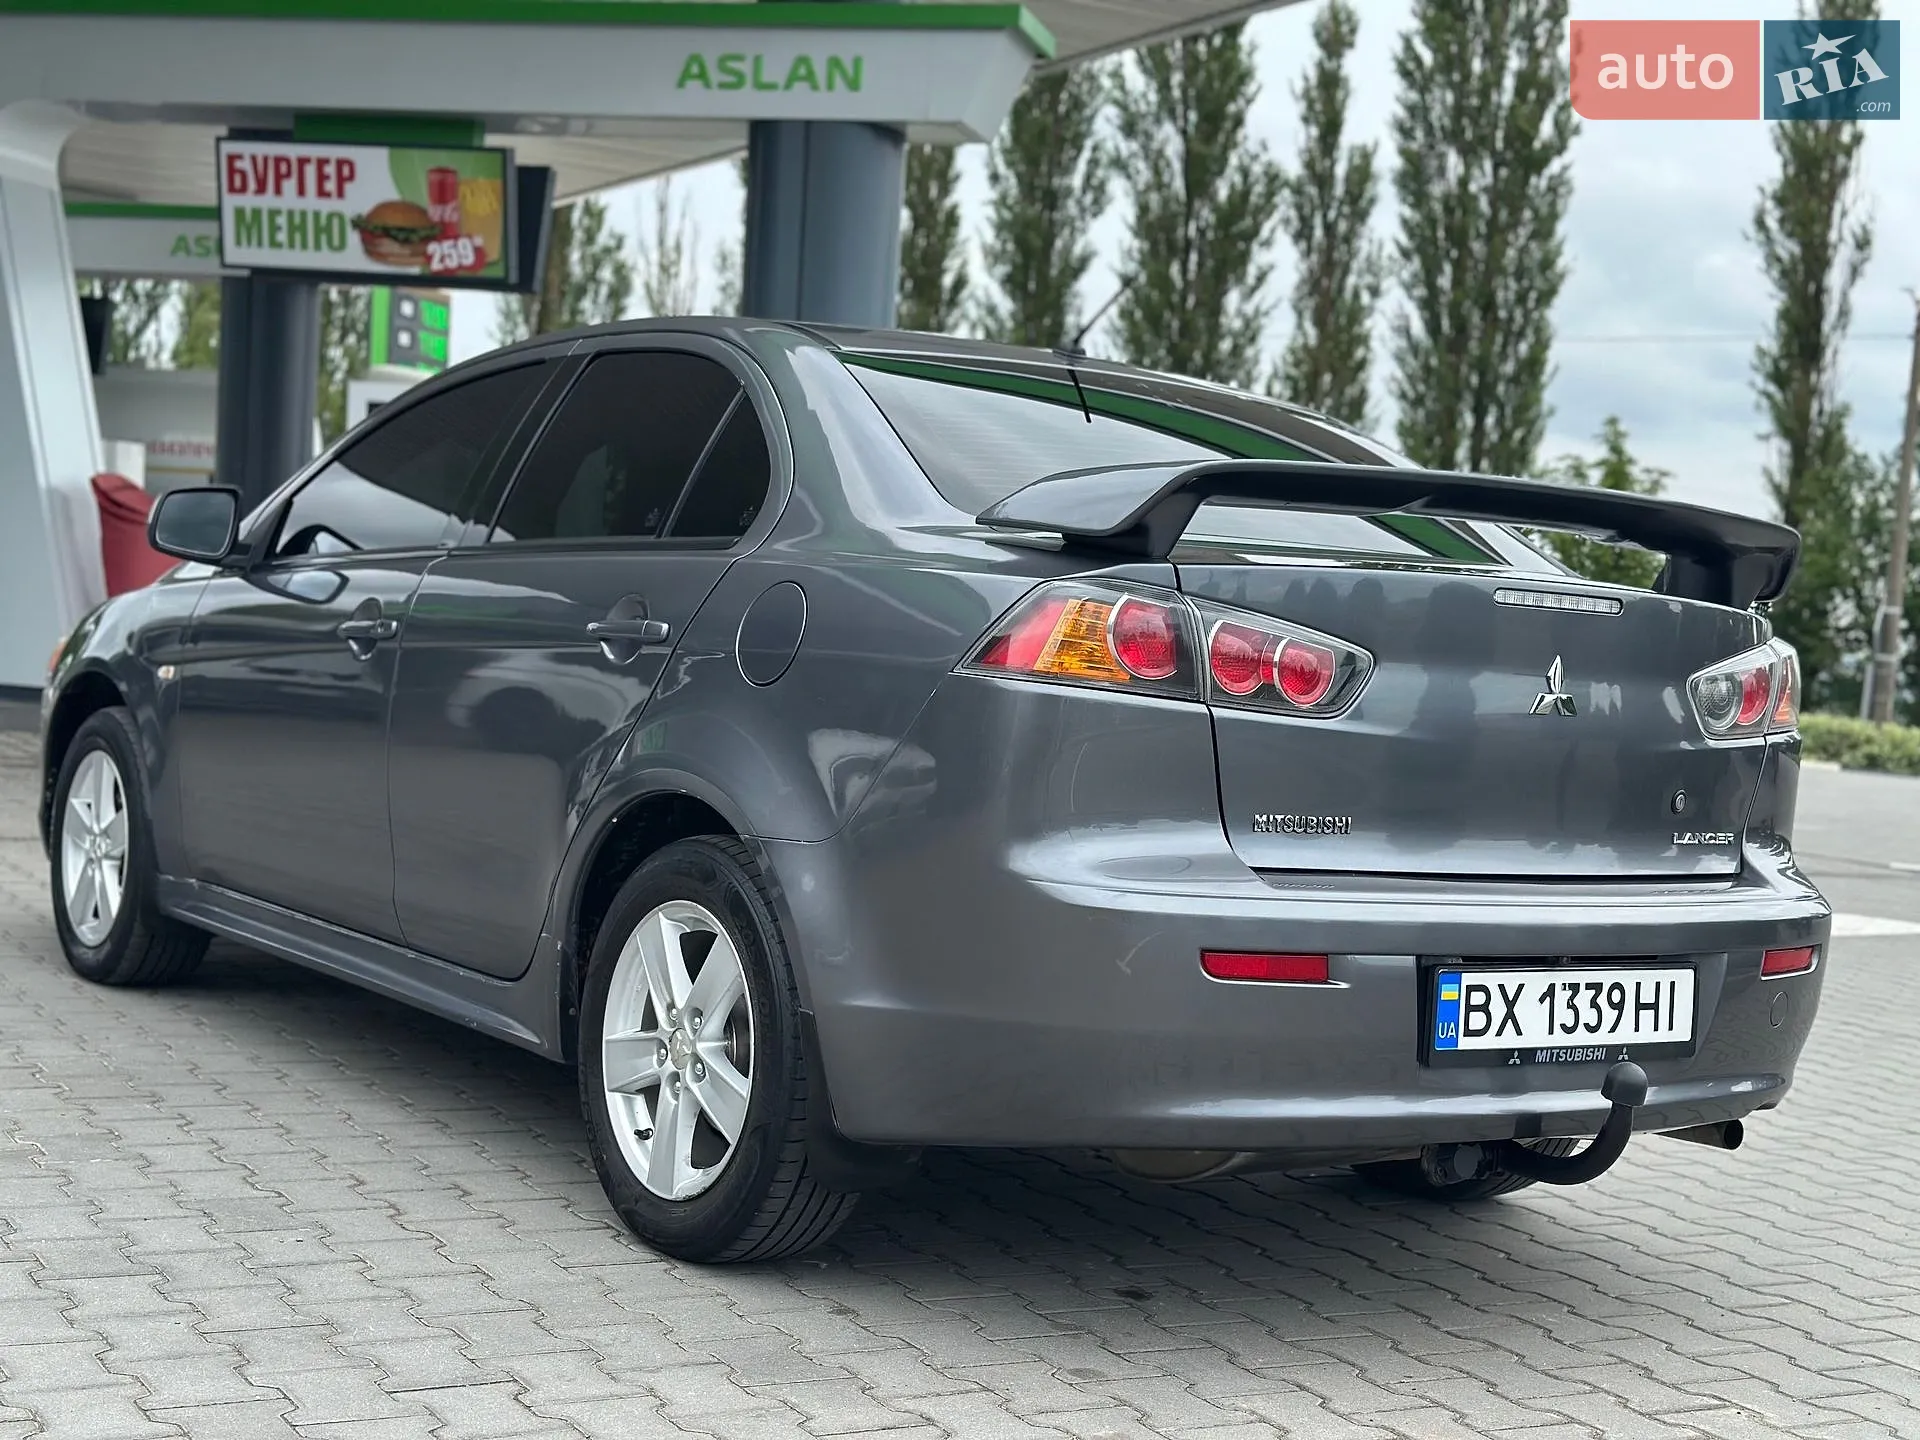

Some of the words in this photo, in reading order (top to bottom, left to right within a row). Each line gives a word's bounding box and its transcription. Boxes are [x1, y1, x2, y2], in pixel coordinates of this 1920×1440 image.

[676, 52, 864, 92] ASLAN
[226, 153, 356, 199] БУРГЕР
[233, 206, 348, 253] МЕНЮ
[1252, 813, 1353, 835] MITSUBISHI
[1672, 832, 1735, 845] LANCER
[1463, 983, 1526, 1037] BX
[1438, 1022, 1457, 1039] UA
[1535, 1047, 1607, 1064] MITSUBISHI
